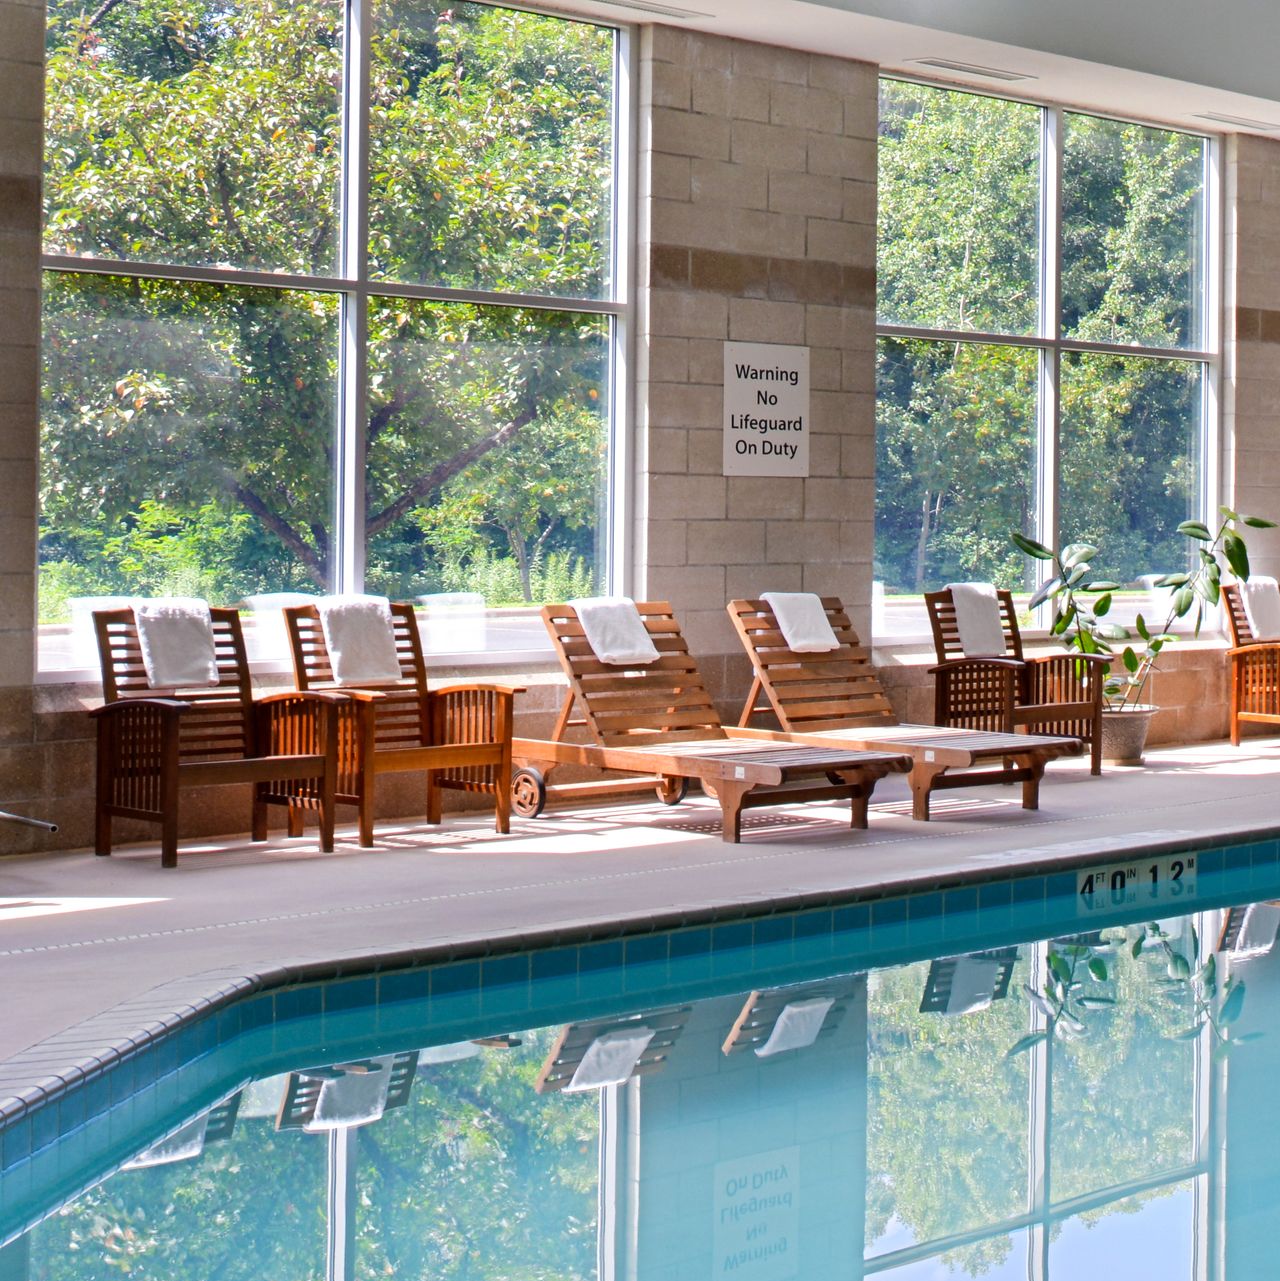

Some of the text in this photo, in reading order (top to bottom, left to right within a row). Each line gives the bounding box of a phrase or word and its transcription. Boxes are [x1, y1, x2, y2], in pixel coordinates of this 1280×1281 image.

[735, 363, 799, 386] Warning
[757, 390, 778, 406] No
[731, 414, 803, 434] Lifeguard
[735, 439, 798, 460] On Duty
